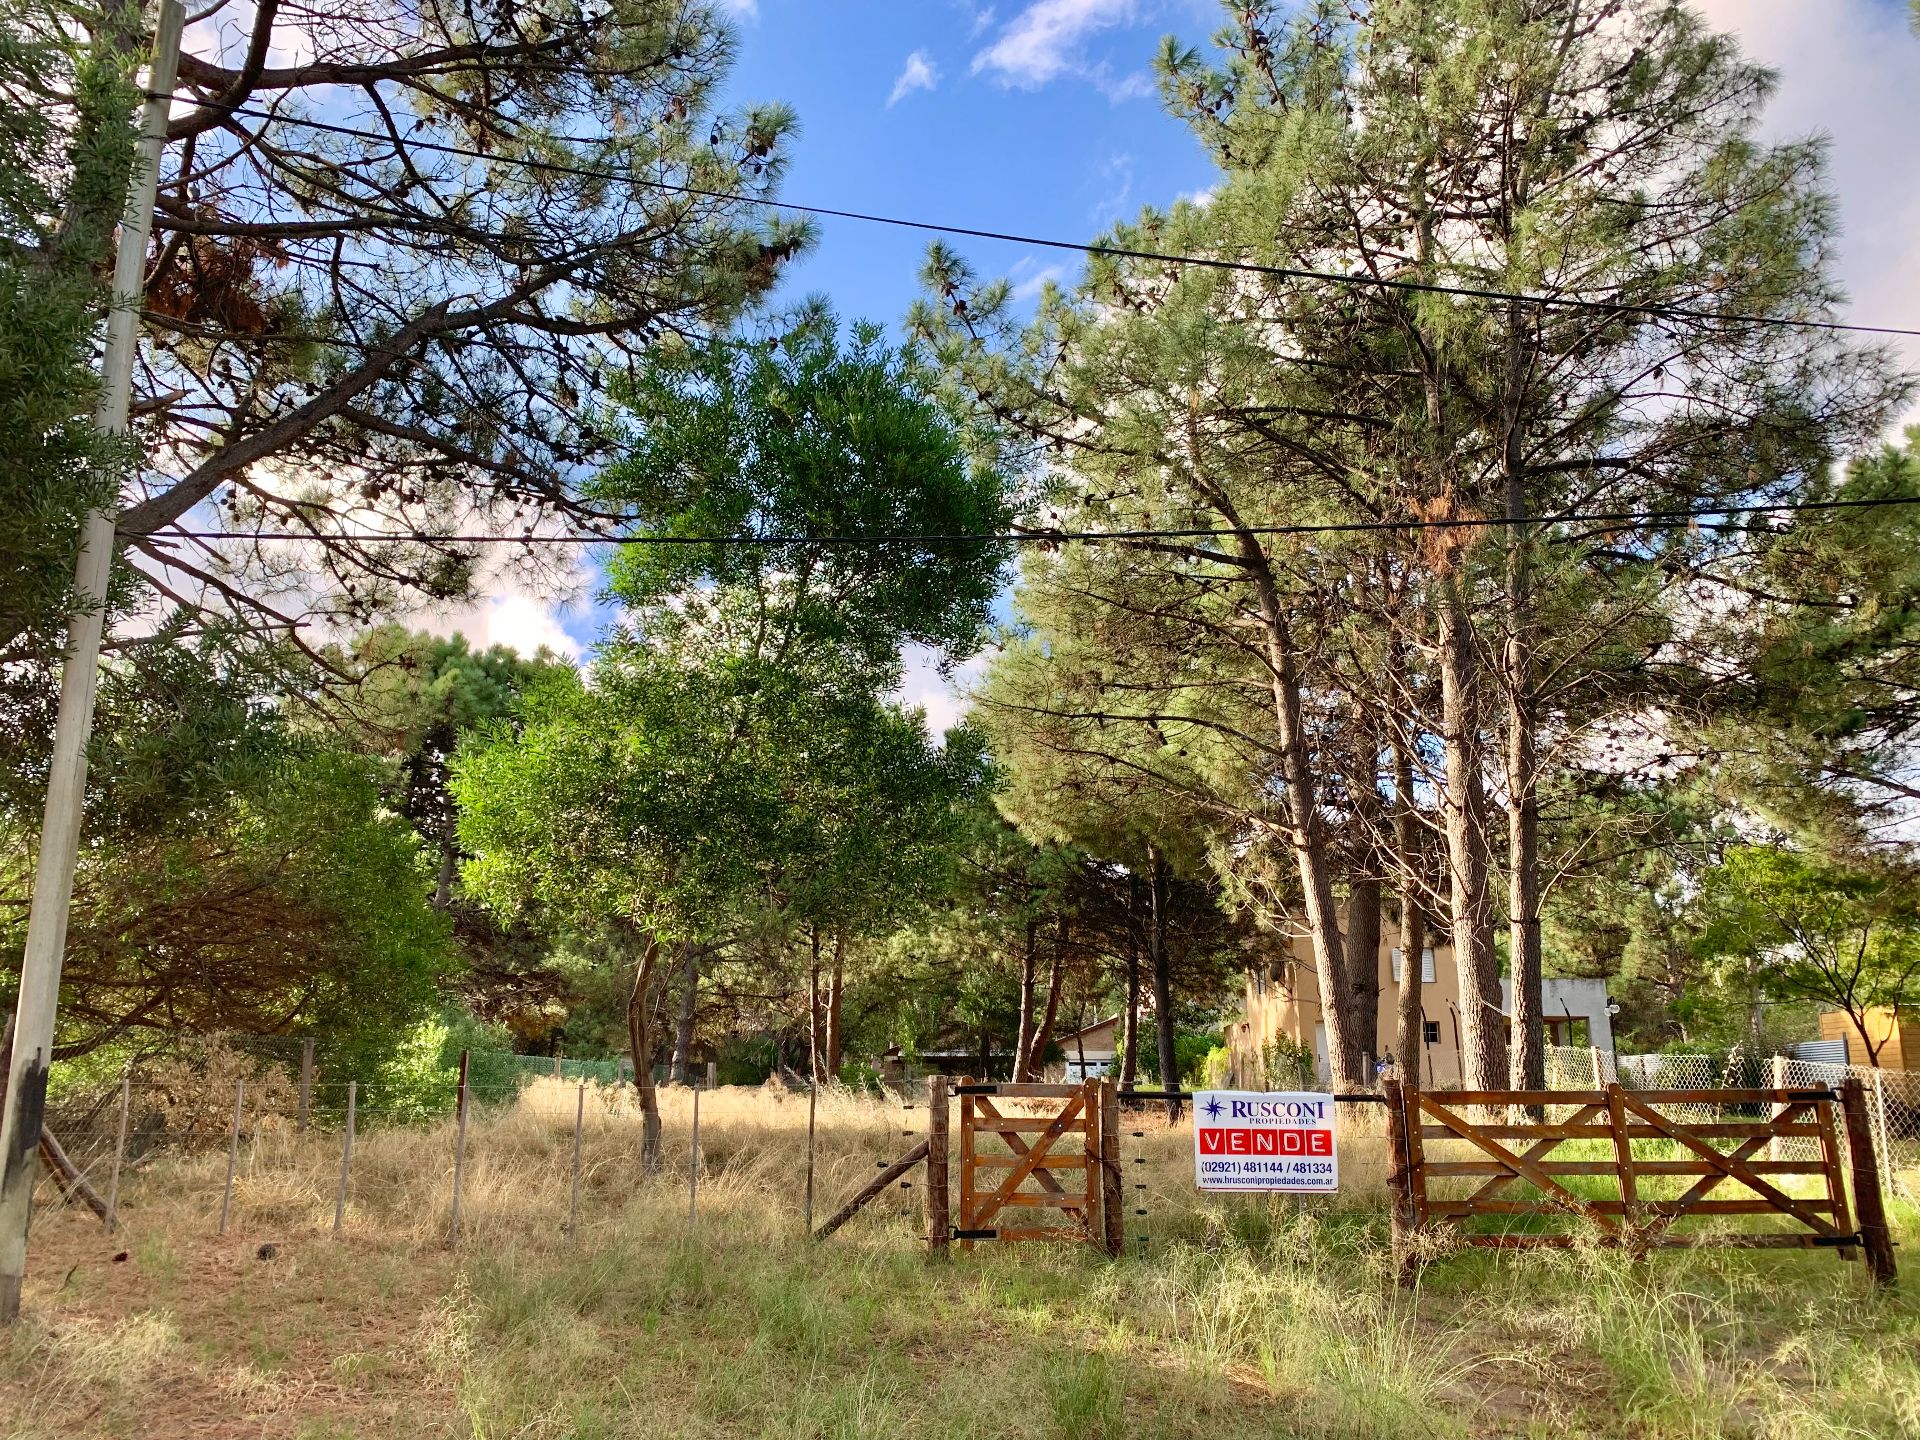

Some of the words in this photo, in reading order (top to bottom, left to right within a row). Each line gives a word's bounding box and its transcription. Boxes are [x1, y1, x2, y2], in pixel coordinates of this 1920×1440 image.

[1231, 1100, 1325, 1119] RUSCONI
[1204, 1132, 1326, 1153] VENDE
[1201, 1161, 1241, 1175] (02921)
[1243, 1161, 1283, 1174] 481144
[1292, 1162, 1333, 1174] 481334
[1202, 1176, 1334, 1187] www.hrusconipropiedades.com.ar
